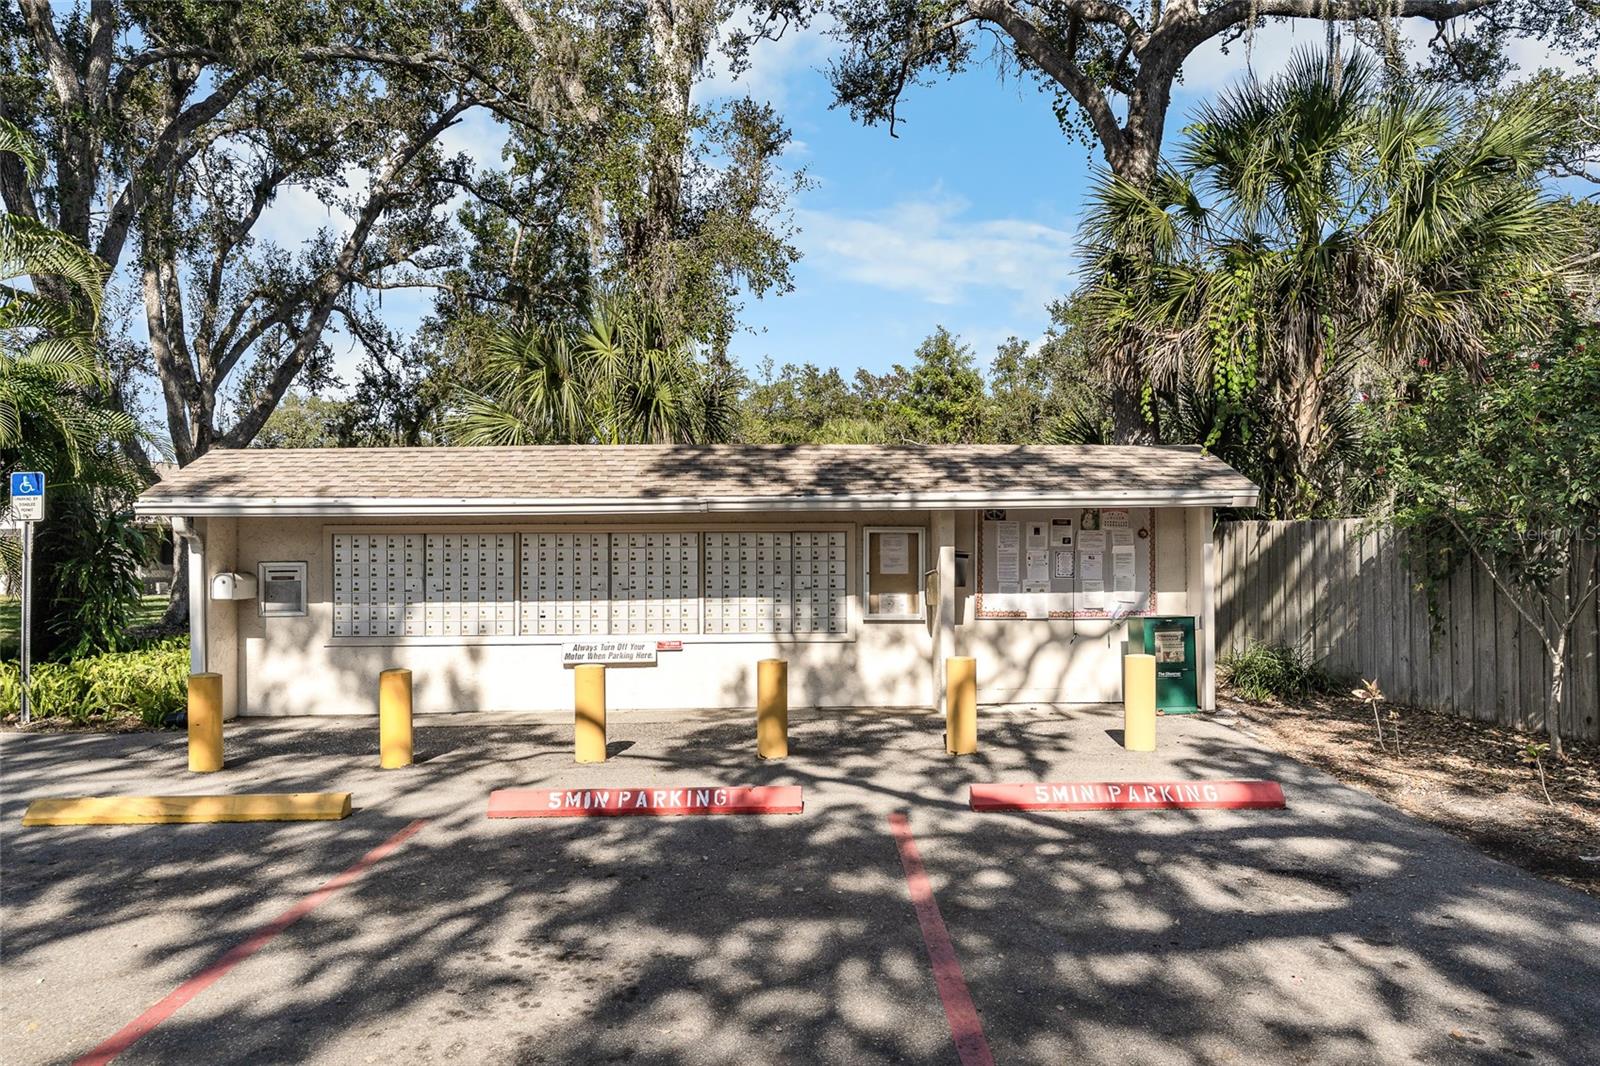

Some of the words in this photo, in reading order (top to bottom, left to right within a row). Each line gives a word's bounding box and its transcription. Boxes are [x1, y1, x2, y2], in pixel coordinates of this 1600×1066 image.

[572, 643, 597, 652] Always
[600, 643, 615, 651] Turn
[617, 643, 627, 651] Off
[630, 643, 645, 651] Your
[564, 652, 585, 660] Motor
[587, 652, 606, 660] When
[608, 651, 634, 660] Parking
[635, 651, 654, 660] Here.
[617, 788, 728, 808] PARKING
[1108, 784, 1218, 803] PARKING
